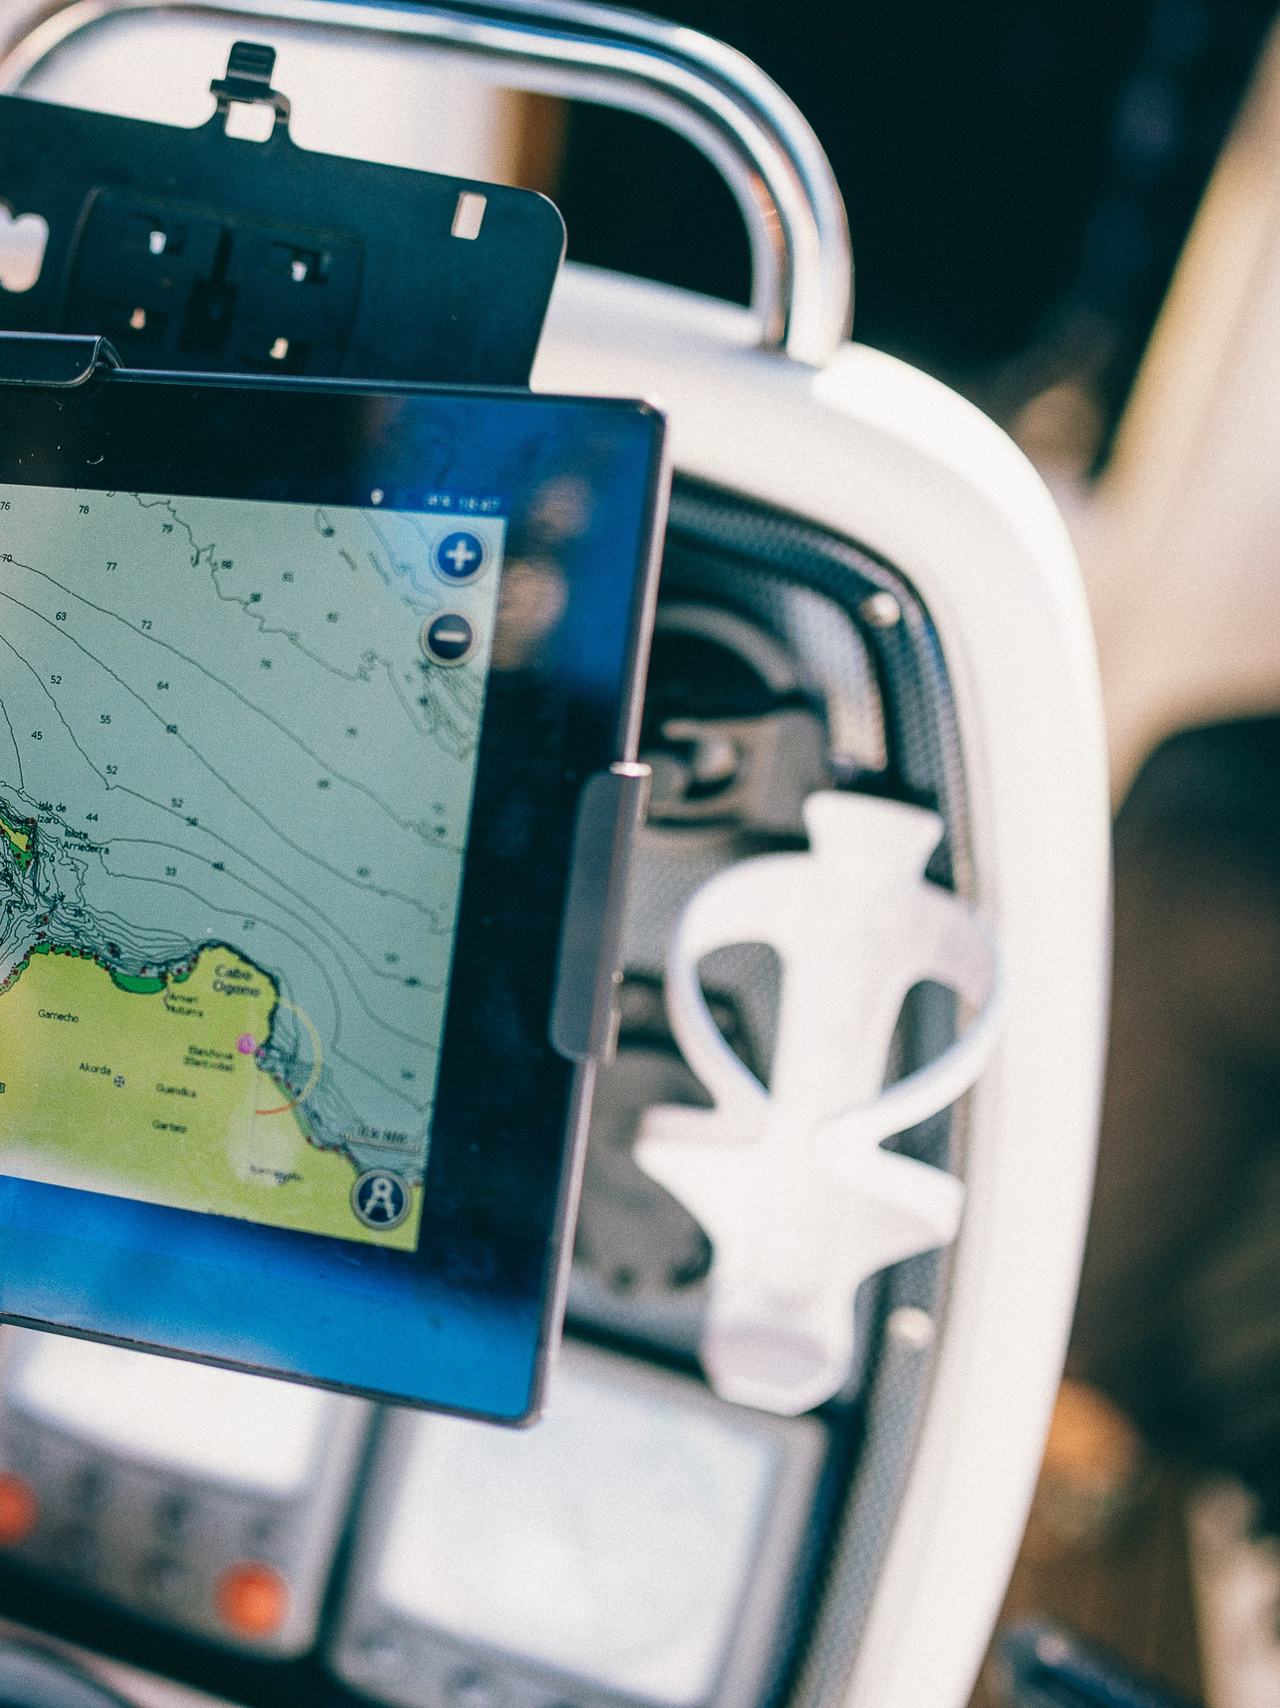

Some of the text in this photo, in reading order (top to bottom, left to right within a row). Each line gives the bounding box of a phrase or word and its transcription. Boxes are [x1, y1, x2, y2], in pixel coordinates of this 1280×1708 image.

[0, 502, 11, 510] 76
[79, 505, 89, 514] 78
[2, 554, 12, 562] 70
[107, 562, 117, 571] 77
[55, 612, 67, 621] 63
[51, 675, 62, 684] 52
[100, 715, 112, 724] 55
[31, 731, 43, 740] 45
[107, 765, 118, 775] 52
[56, 802, 67, 813] de
[37, 814, 59, 825] Izaro
[86, 813, 98, 822] 44
[215, 964, 253, 980] Cabo
[38, 1010, 79, 1023] Gamecho
